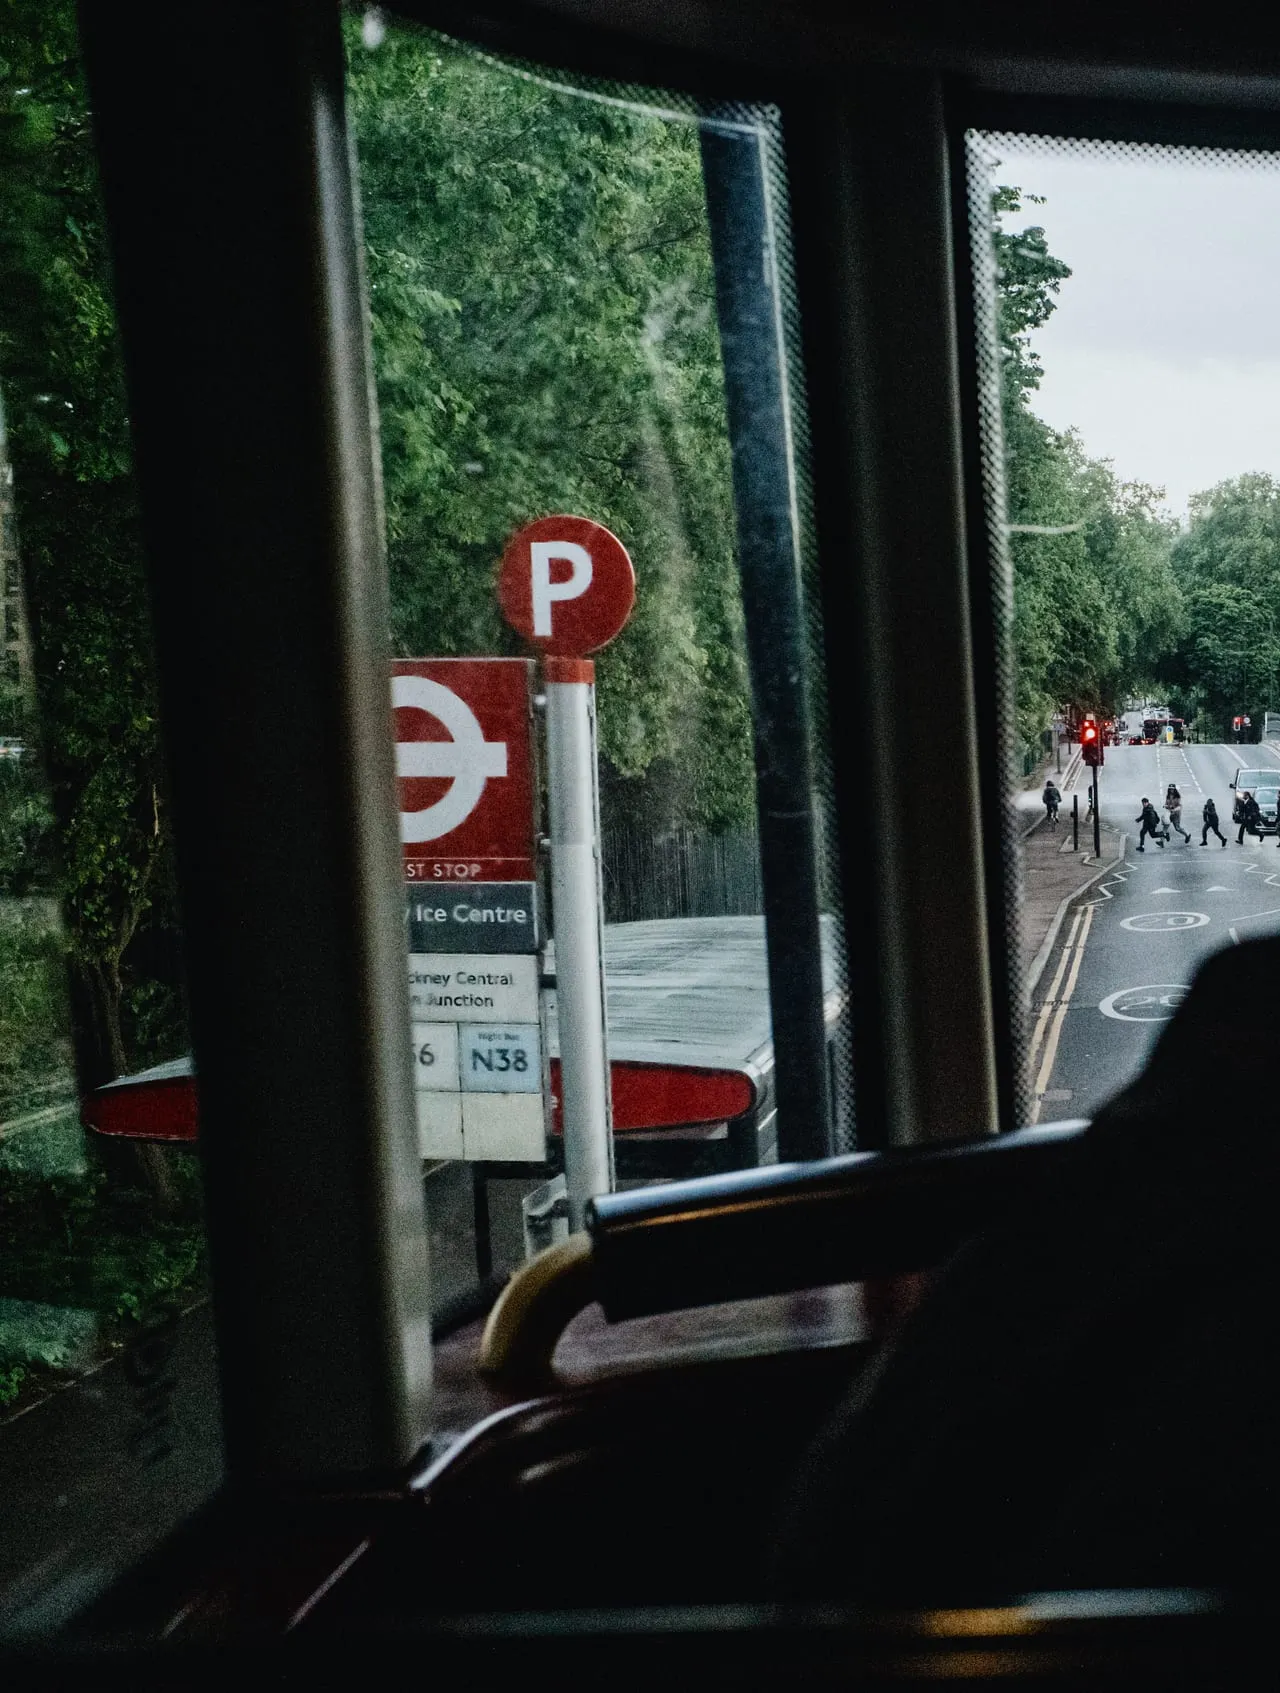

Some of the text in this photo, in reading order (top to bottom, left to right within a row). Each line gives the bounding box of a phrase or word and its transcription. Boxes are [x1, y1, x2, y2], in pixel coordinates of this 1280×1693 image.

[531, 541, 593, 637] P
[406, 863, 482, 878] ST STOP
[416, 904, 447, 922] Ice
[453, 904, 528, 924] Centre
[456, 971, 514, 986] Central
[427, 993, 495, 1007] Junction
[471, 1048, 529, 1073] N38
